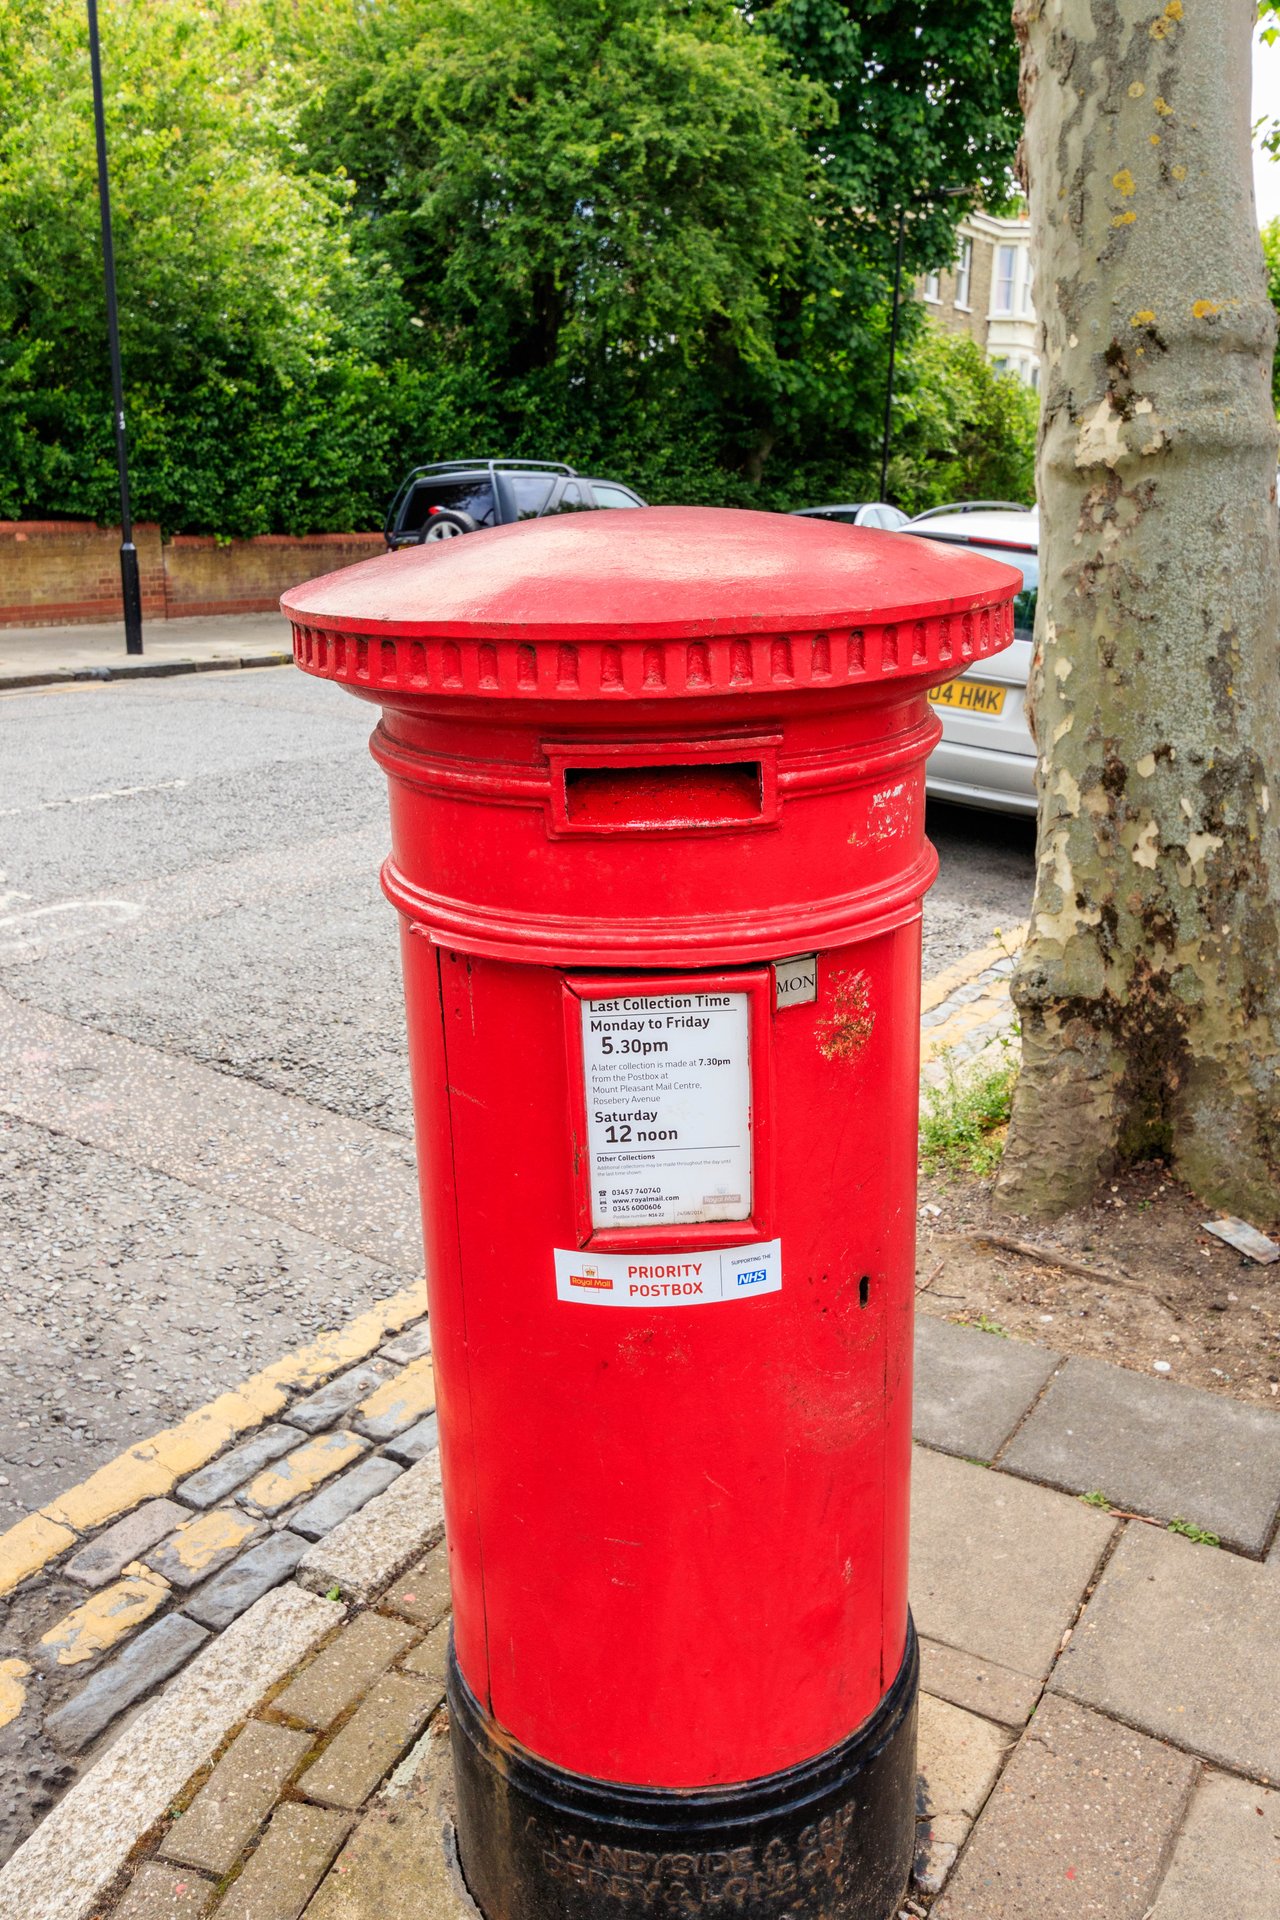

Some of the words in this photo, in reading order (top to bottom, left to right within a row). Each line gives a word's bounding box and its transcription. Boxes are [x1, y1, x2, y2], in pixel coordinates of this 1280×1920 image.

[959, 687, 1000, 710] HMK
[776, 973, 815, 994] MON
[589, 1000, 620, 1012] Last
[623, 997, 692, 1010] Collection
[695, 995, 730, 1007] Time
[590, 1020, 644, 1032] Monday
[648, 1018, 662, 1029] to
[666, 1016, 710, 1029] Friday
[601, 1036, 669, 1056] 5.30pm
[598, 1063, 617, 1071] later
[618, 1062, 656, 1070] collection
[665, 1060, 687, 1068] made
[689, 1059, 697, 1067] at
[698, 1058, 731, 1067] 7.30pm
[592, 1075, 611, 1083] from
[612, 1074, 626, 1082] the
[627, 1073, 659, 1081] Postbox
[592, 1086, 618, 1094] Mount
[620, 1084, 654, 1093] Pleasant
[655, 1083, 672, 1091] Mail
[593, 1097, 630, 1105] Rosebery
[631, 1095, 660, 1103] Avenue
[595, 1110, 658, 1123] Saturday
[605, 1125, 632, 1143] 12
[637, 1129, 678, 1142] noon
[597, 1155, 616, 1163] Other
[618, 1154, 655, 1162] Collections
[612, 1188, 635, 1196] 03457
[612, 1195, 680, 1204] www.royalmail.com
[731, 1256, 761, 1266] SUPPORTING
[628, 1263, 703, 1279] PRIORITY
[738, 1270, 766, 1285] NHS
[571, 1277, 593, 1286] Royal
[594, 1278, 612, 1287] Mail
[629, 1282, 704, 1297] POSTBOX
